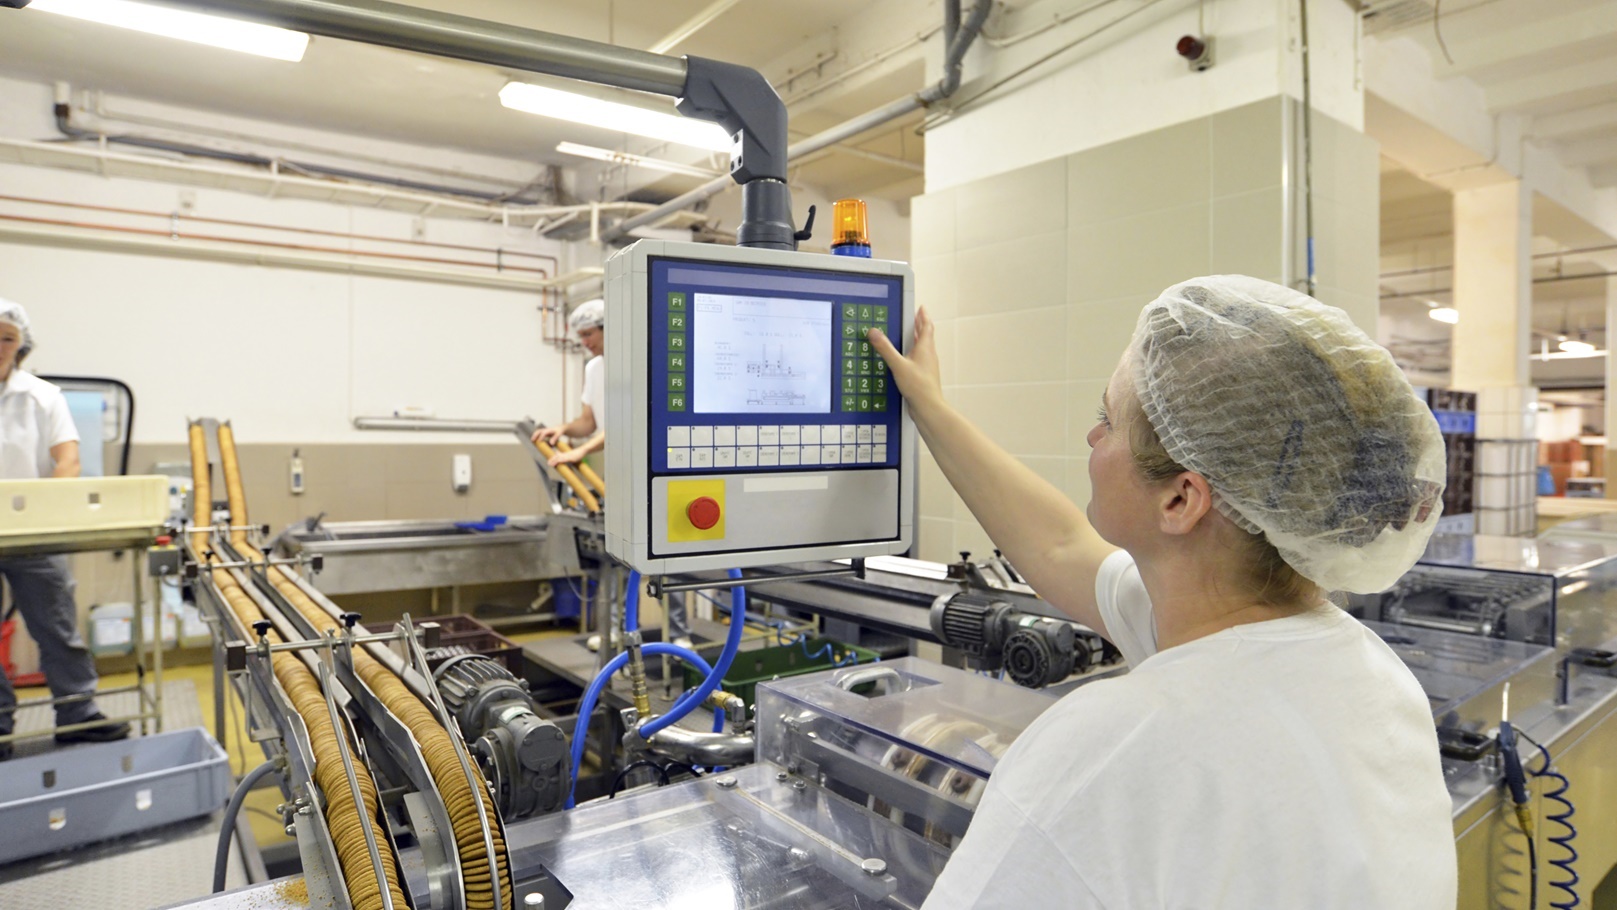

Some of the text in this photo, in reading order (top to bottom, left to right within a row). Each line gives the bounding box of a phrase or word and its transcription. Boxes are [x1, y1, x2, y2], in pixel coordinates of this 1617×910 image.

[847, 342, 853, 351] 7
[862, 343, 868, 352] 8
[847, 360, 853, 369] 4
[862, 361, 868, 370] 5
[878, 362, 884, 370] 6
[847, 379, 852, 387] 1
[862, 379, 868, 388] 2
[878, 380, 884, 388] 3
[862, 400, 868, 409] 0
